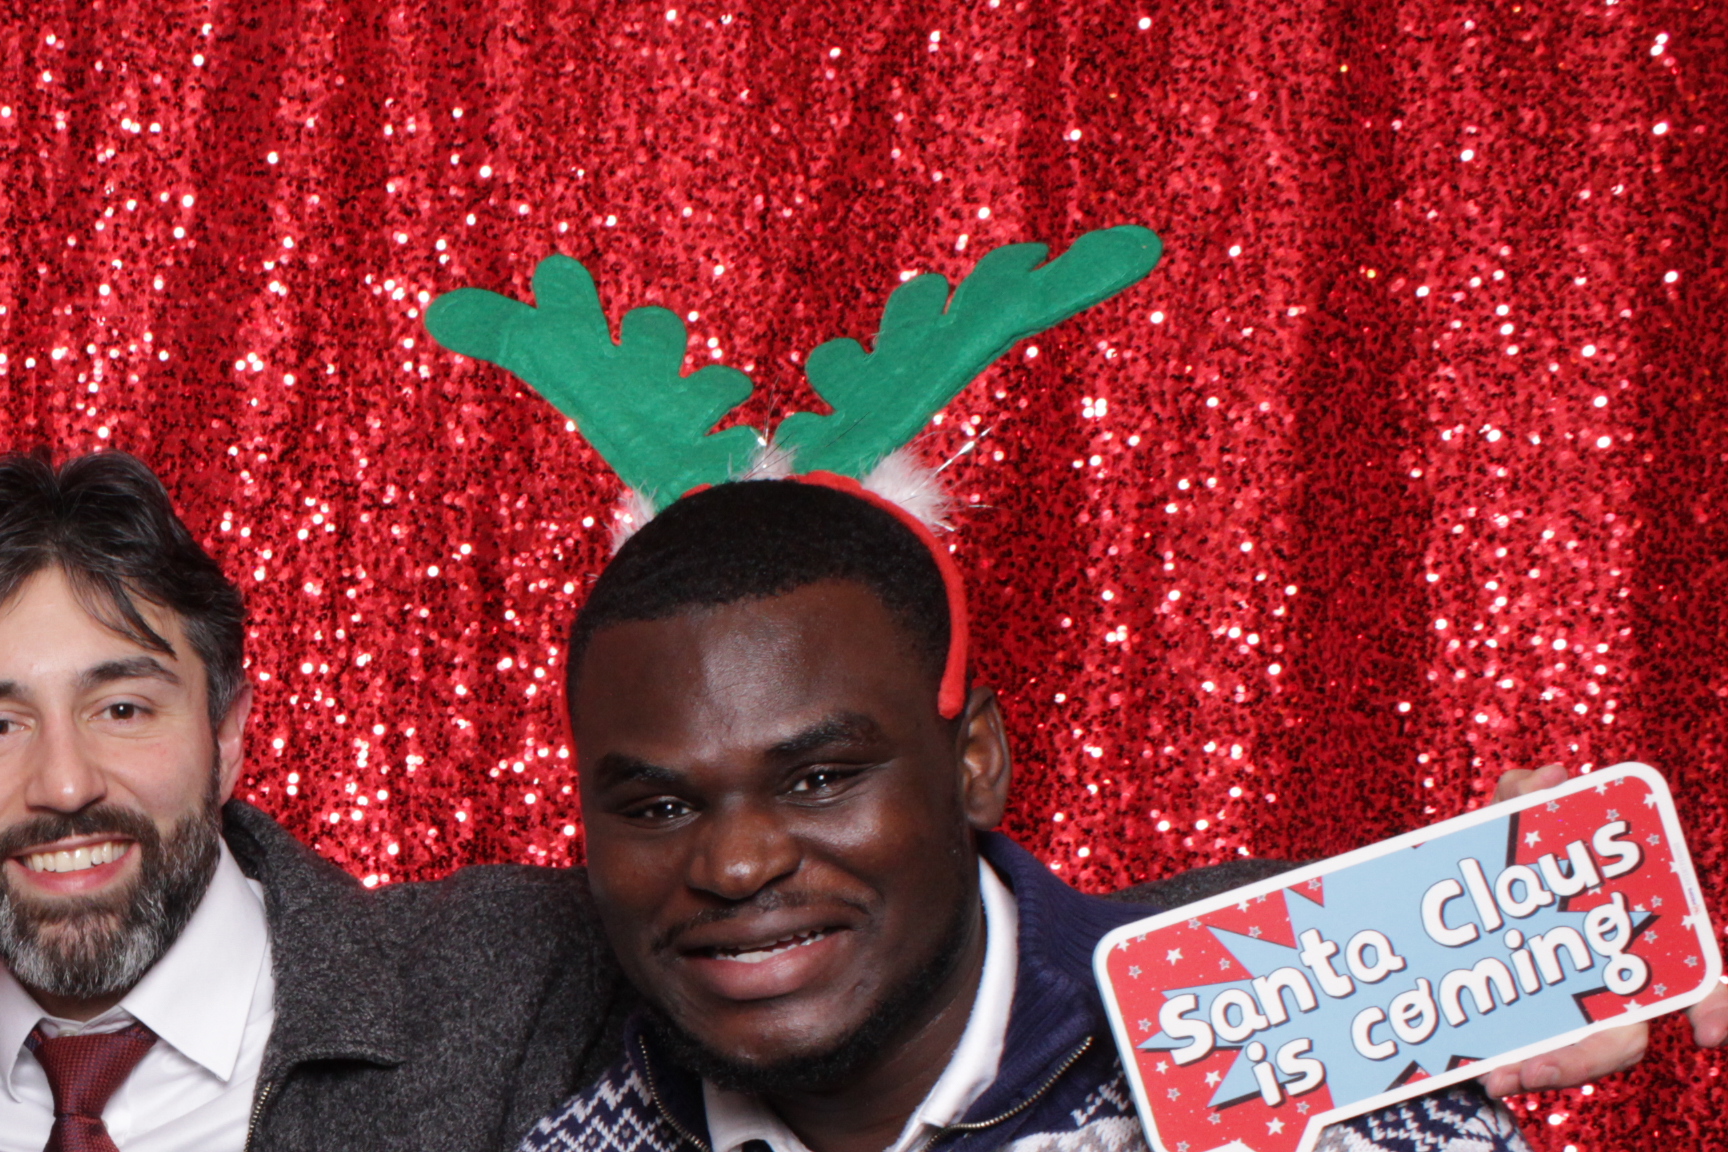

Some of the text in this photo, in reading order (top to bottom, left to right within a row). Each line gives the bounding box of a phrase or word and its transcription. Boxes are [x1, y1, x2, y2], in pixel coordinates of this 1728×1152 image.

[1158, 821, 1640, 1064] Santa Claus
[1245, 893, 1648, 1105] is coming
